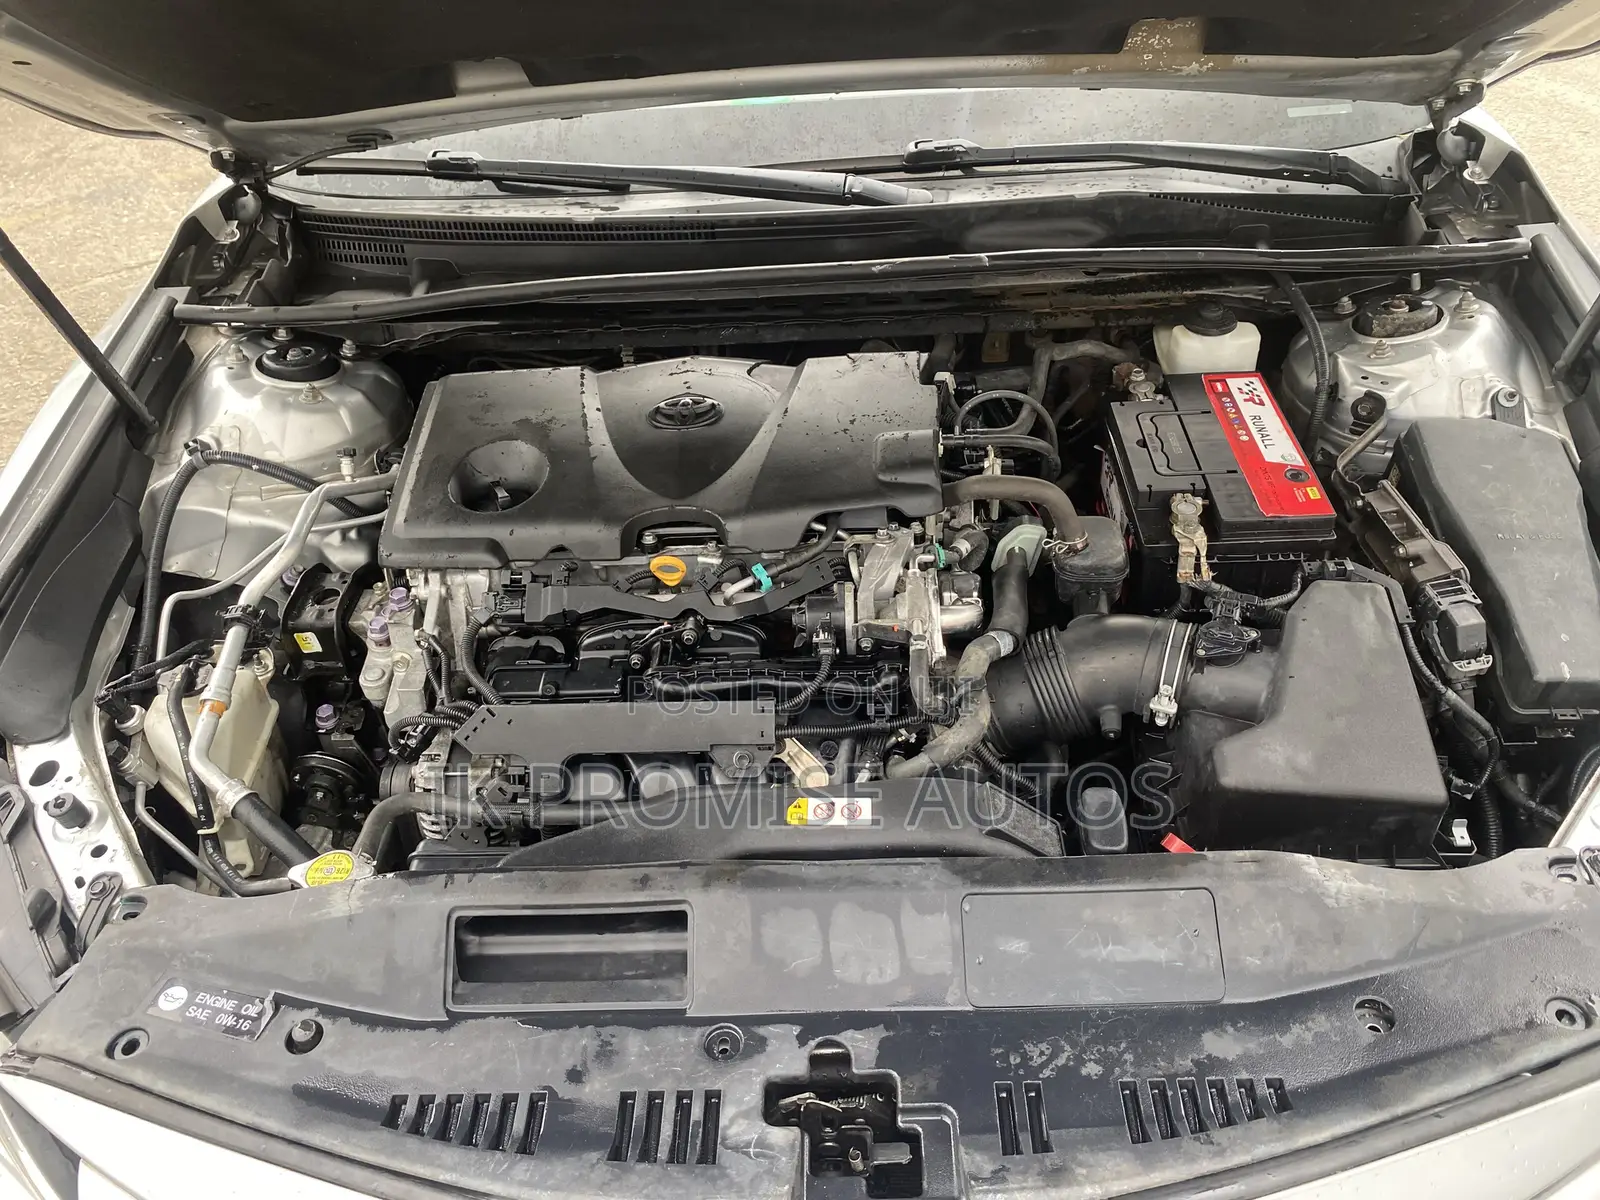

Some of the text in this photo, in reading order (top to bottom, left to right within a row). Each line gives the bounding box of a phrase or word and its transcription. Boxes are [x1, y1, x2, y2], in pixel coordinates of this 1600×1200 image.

[1248, 414, 1276, 450] RUNALL
[195, 992, 260, 1017] ENGINE OIL
[185, 1005, 252, 1031] SAE 0W-16
